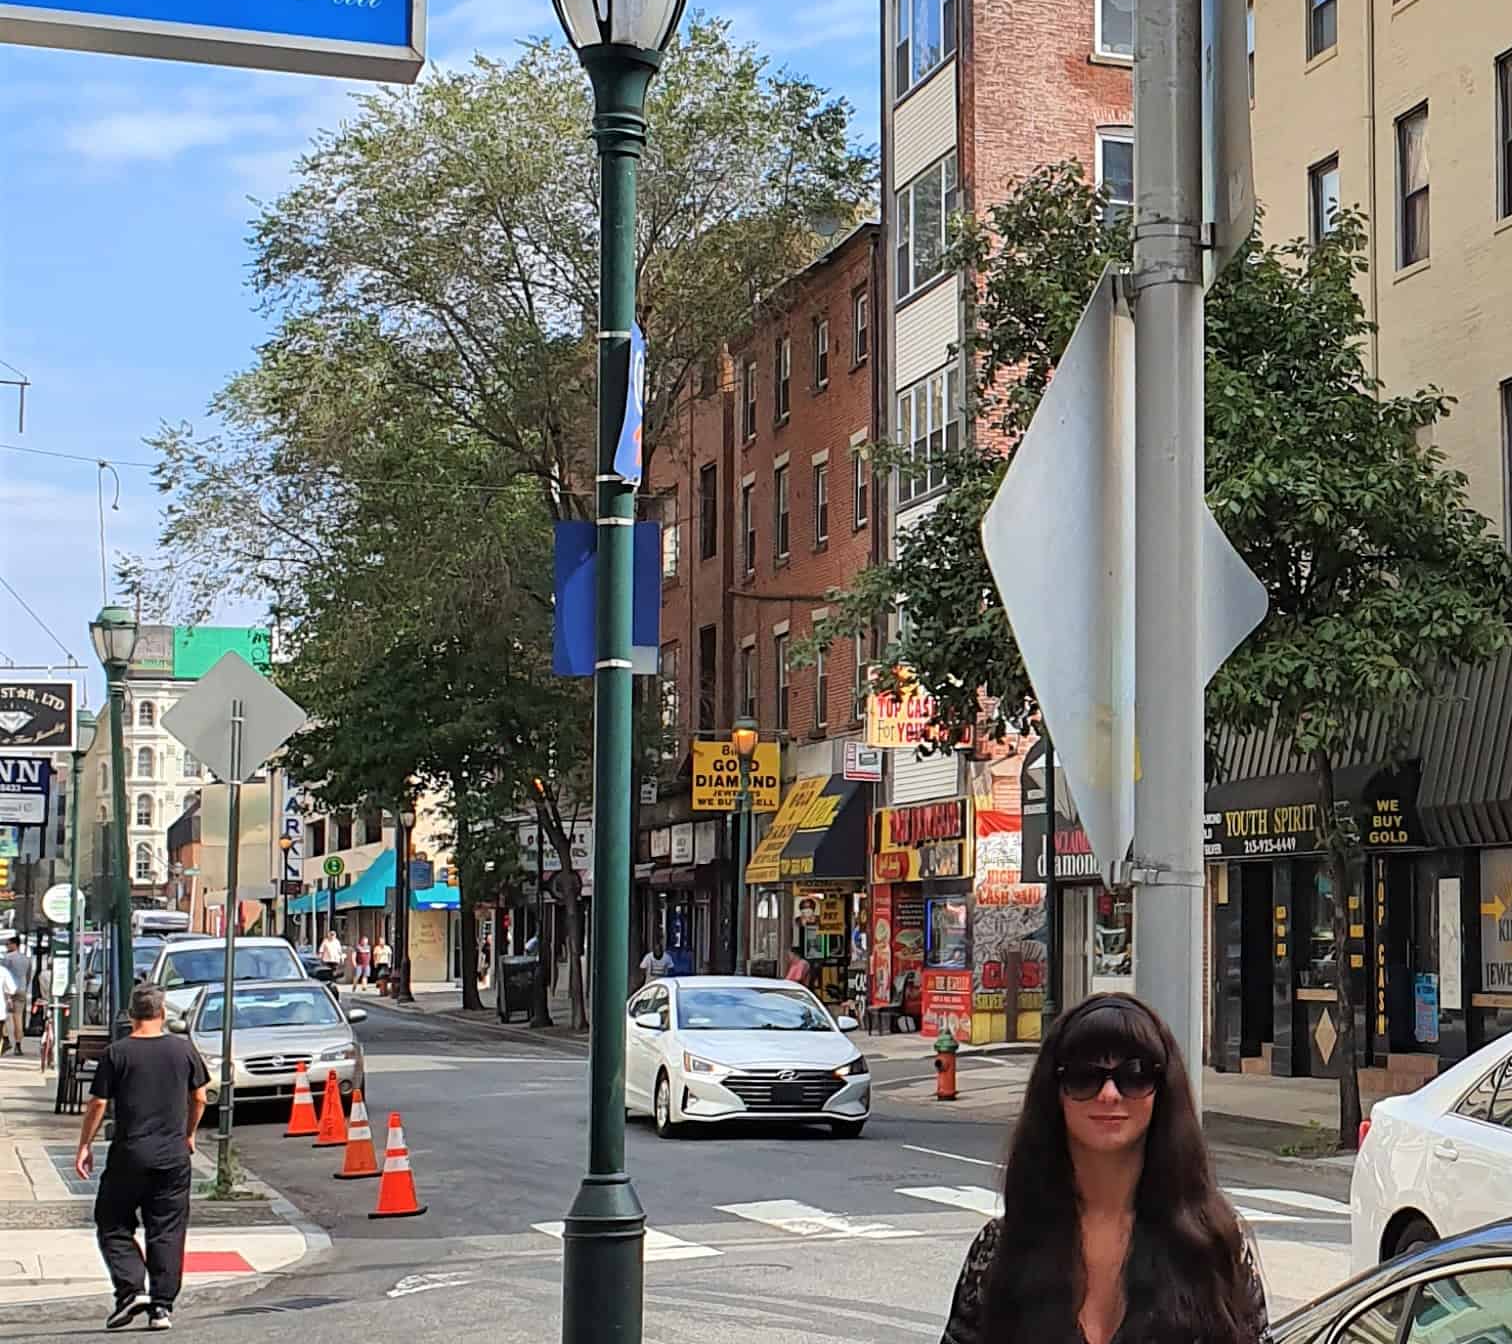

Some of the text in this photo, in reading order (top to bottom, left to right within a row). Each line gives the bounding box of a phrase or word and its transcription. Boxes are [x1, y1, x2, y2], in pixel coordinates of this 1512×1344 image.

[41, 692, 65, 711] LTD
[878, 719, 896, 743] For
[713, 759, 760, 773] GOD
[695, 774, 777, 789] DIAMND
[1377, 799, 1400, 812] WE
[1225, 809, 1268, 837] YOUTH
[1273, 803, 1317, 833] SPIRIT
[1373, 815, 1403, 828] BUY
[1369, 830, 1409, 844] GOLD
